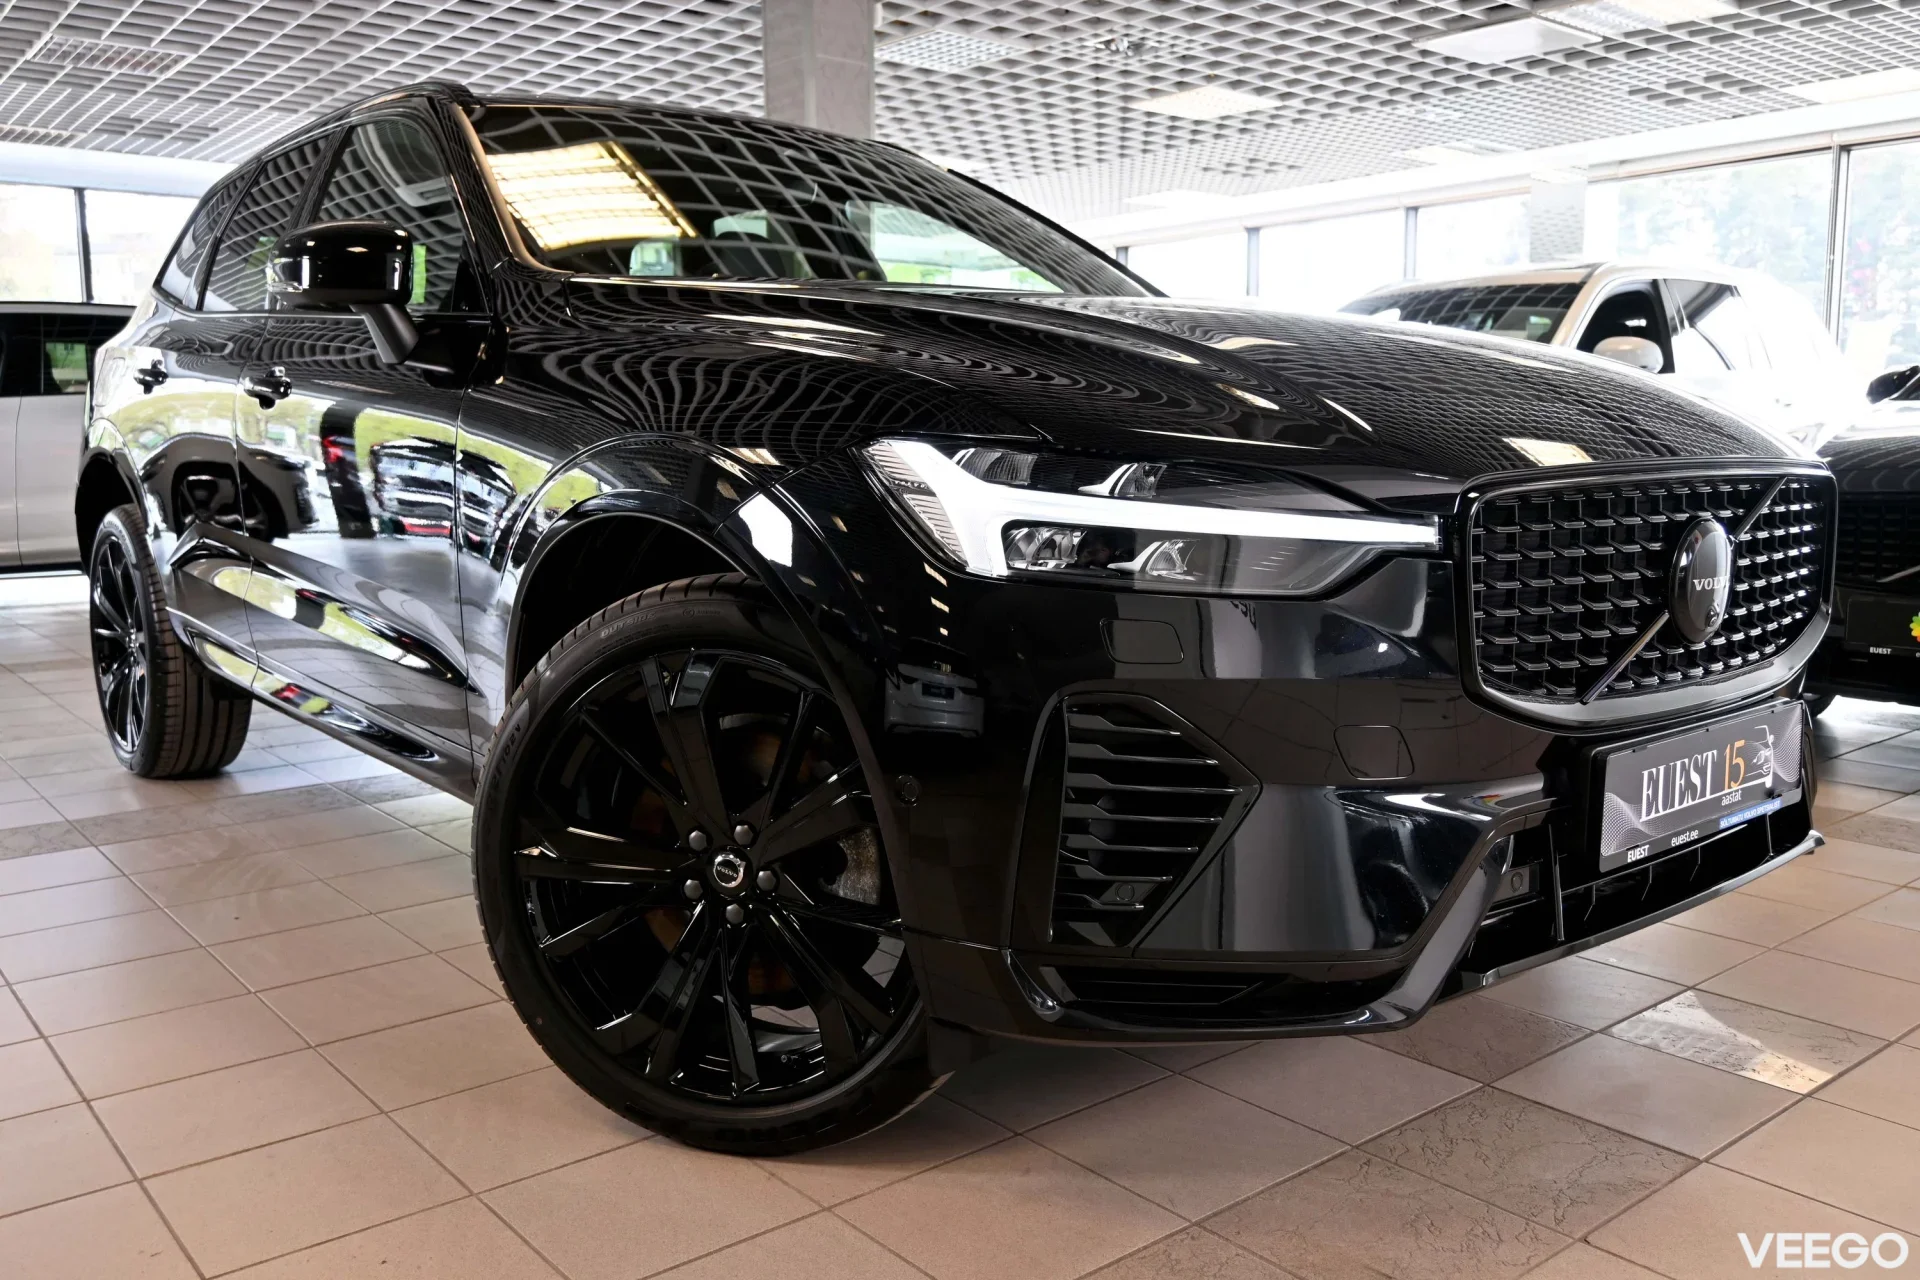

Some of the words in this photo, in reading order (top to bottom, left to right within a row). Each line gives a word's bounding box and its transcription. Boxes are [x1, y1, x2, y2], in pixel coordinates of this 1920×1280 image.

[1693, 576, 1730, 590] VOLV
[600, 611, 657, 639] OUTSIDE
[1869, 646, 1892, 655] EUEST
[1641, 750, 1717, 818] EUEST
[1723, 739, 1745, 791] 15
[1721, 790, 1742, 806] aastat
[1671, 829, 1699, 847] euest.ee
[1627, 845, 1650, 863] EUEST
[716, 865, 738, 878] VOLVO
